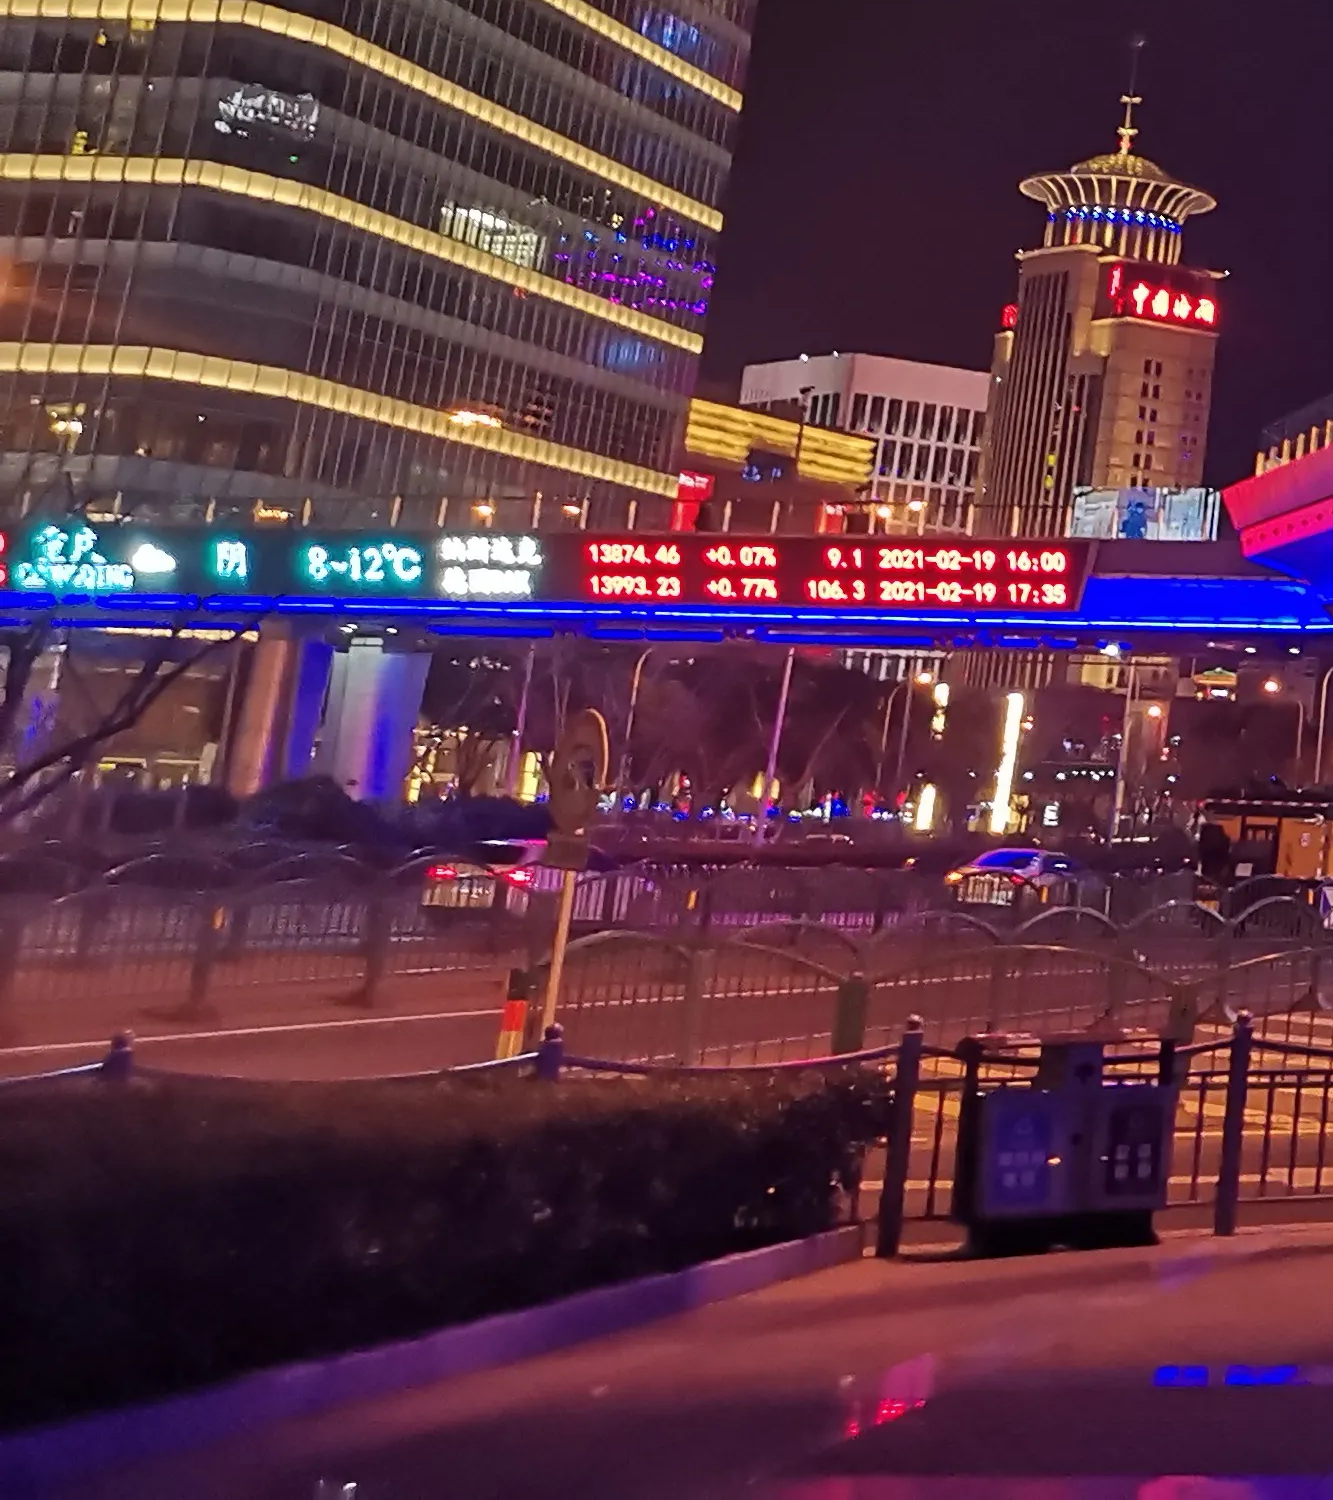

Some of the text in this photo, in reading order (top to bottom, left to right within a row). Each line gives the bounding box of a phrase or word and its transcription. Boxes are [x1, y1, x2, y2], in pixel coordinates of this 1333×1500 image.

[588, 543, 681, 565] 13874.46
[705, 546, 777, 567] +0.07%
[827, 548, 862, 569] 9.1
[878, 549, 996, 571] 2021-02-19
[1006, 551, 1066, 573] 16:00
[589, 575, 1067, 605] 13993.23 +0.77% 106.3 2021-02-19 17:35
